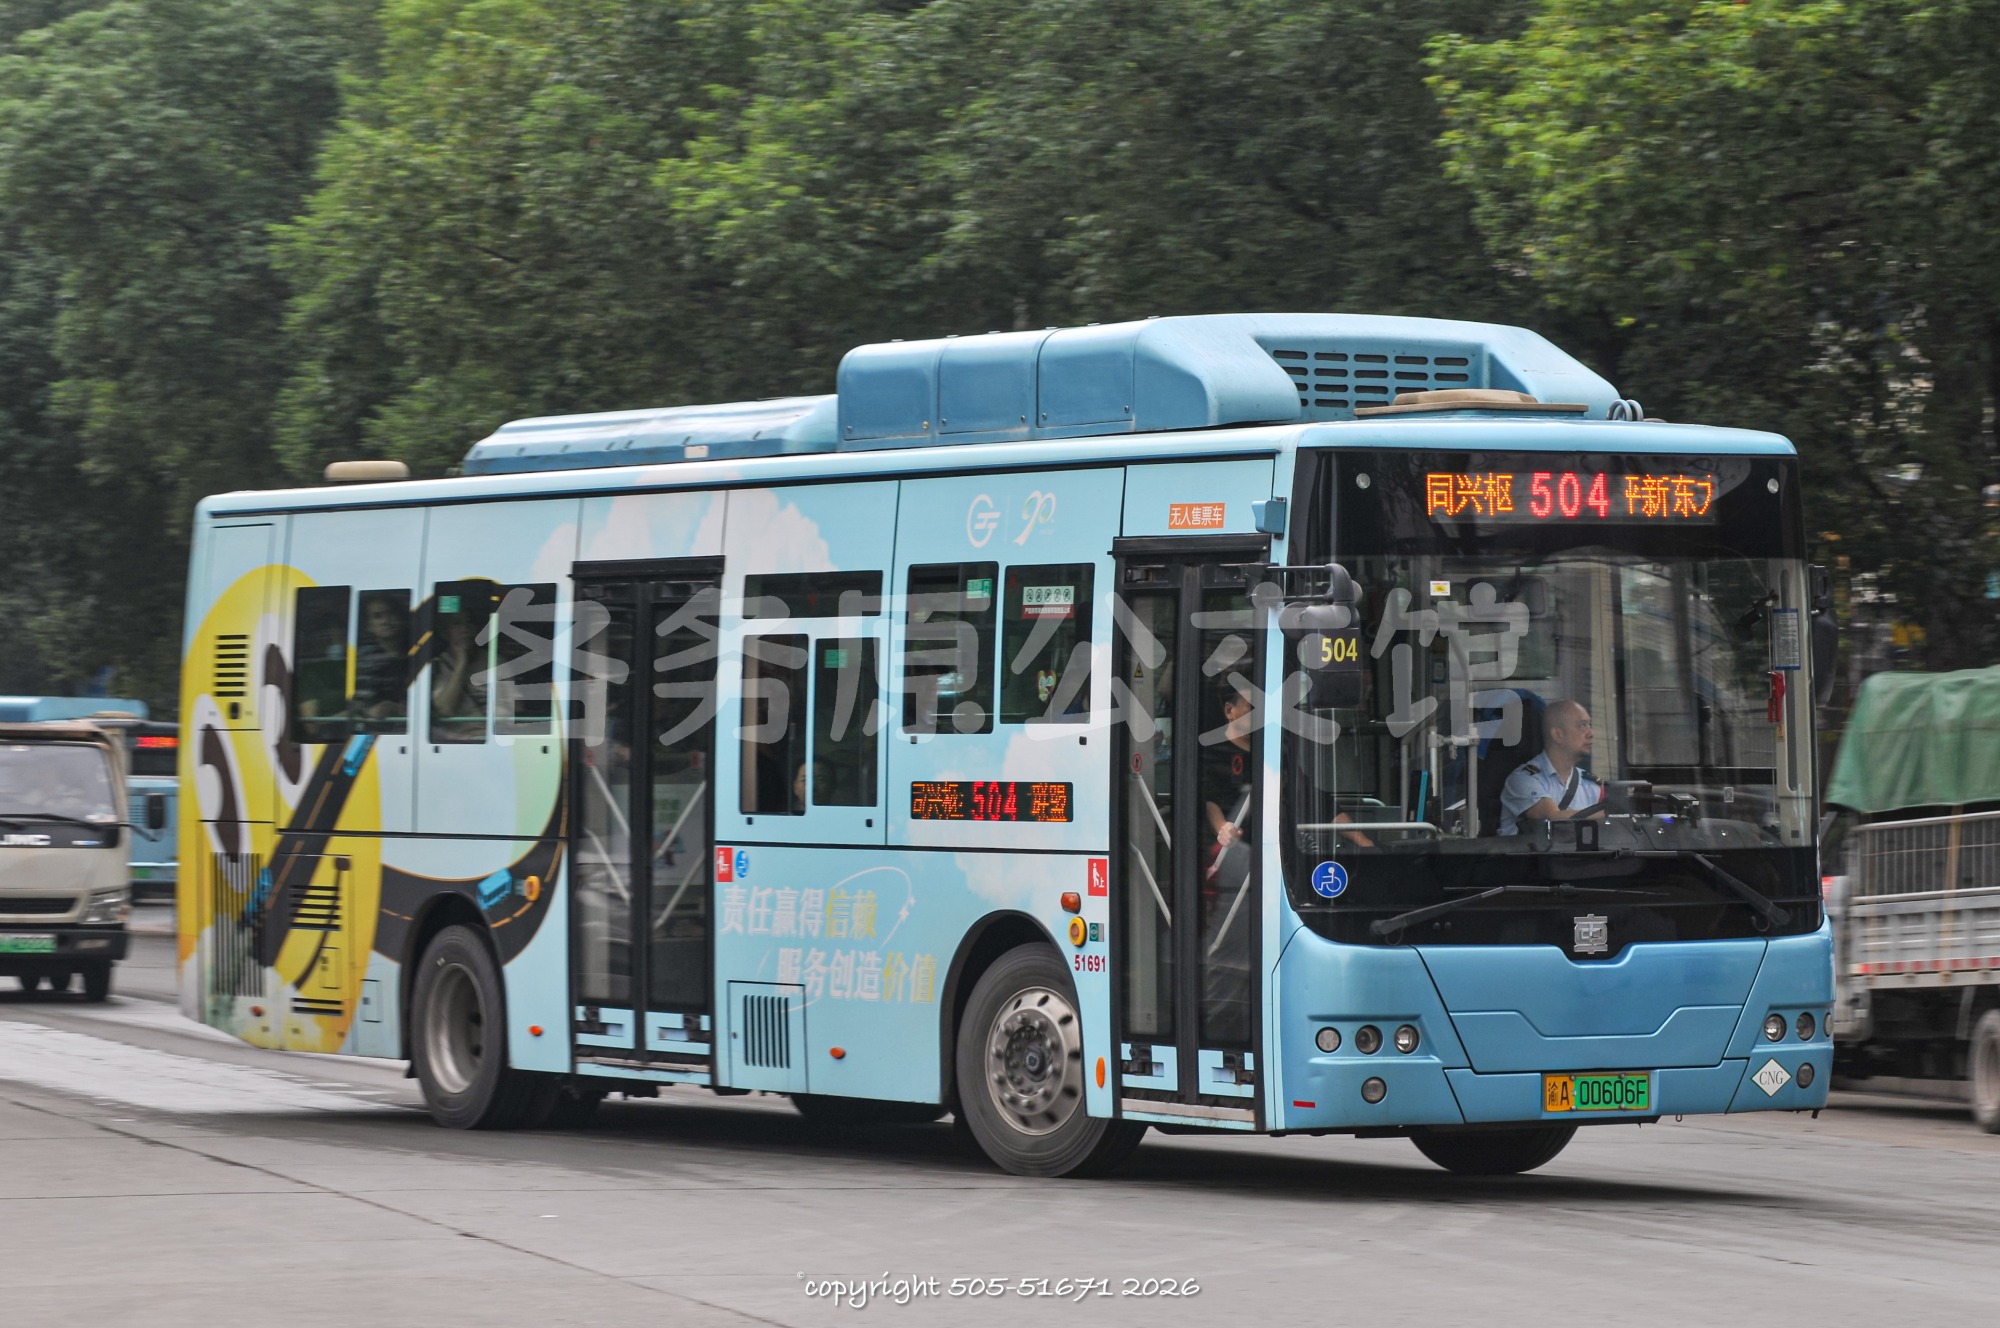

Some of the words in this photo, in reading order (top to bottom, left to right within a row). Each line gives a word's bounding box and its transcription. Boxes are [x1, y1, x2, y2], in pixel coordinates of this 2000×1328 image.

[1426, 472, 1513, 516] 同兴枢
[1530, 472, 1610, 518] 504
[1170, 506, 1223, 526] 无人售票车
[1321, 638, 1358, 662] 504
[971, 781, 1018, 821] 504
[720, 885, 877, 940] 责任赢得信赖
[775, 947, 937, 1003] 服务创造价值
[1074, 954, 1106, 973] 51691
[1758, 1069, 1784, 1085] CNG
